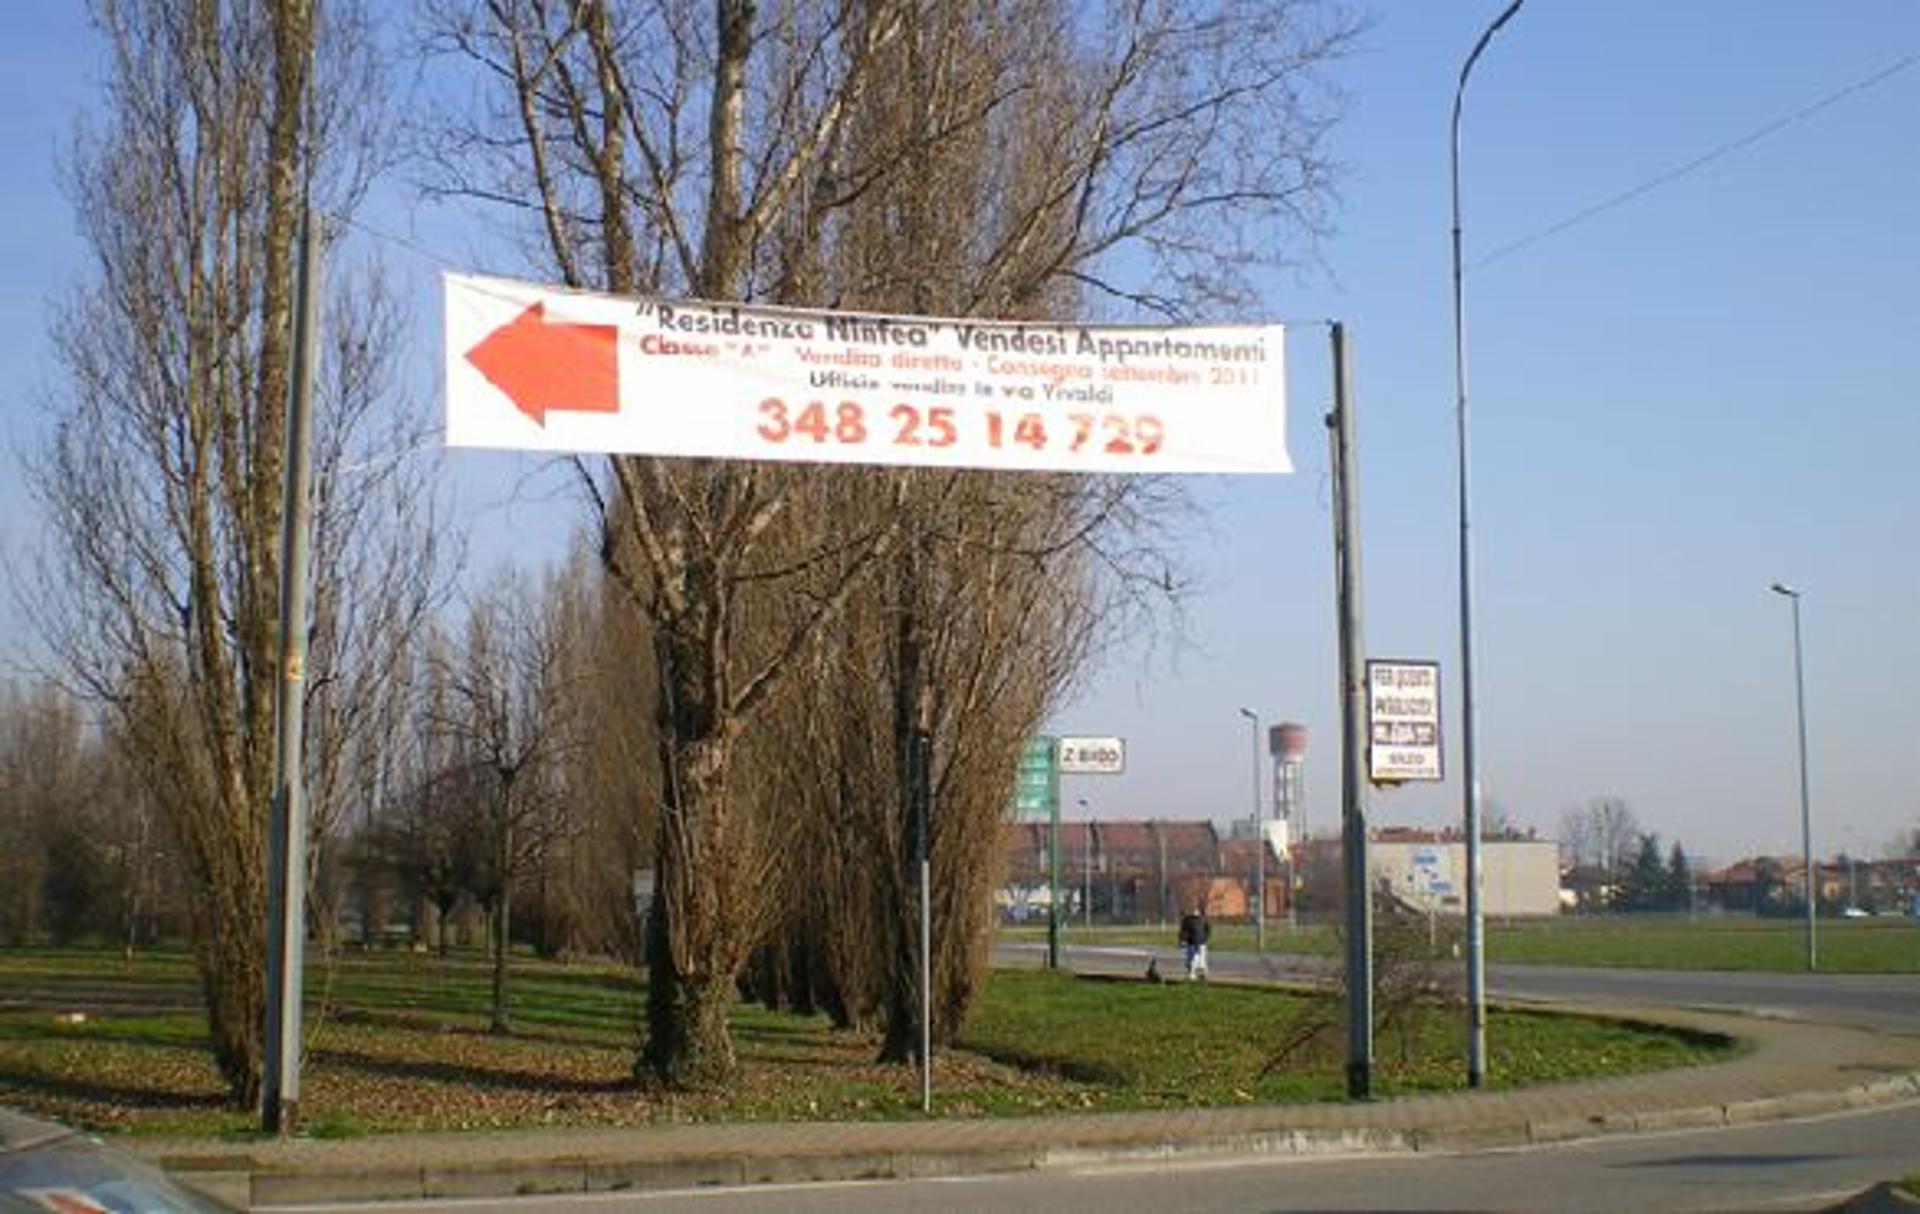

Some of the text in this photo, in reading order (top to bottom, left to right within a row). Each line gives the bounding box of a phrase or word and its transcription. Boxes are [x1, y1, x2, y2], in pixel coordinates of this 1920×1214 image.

[639, 334, 721, 356] Classe
[987, 355, 1093, 382] Consegna
[955, 325, 1066, 355] Vendesi
[1076, 329, 1266, 364] Appartamenti
[1043, 383, 1114, 403] Vivaldi
[756, 397, 1165, 455] 348 25 14 729
